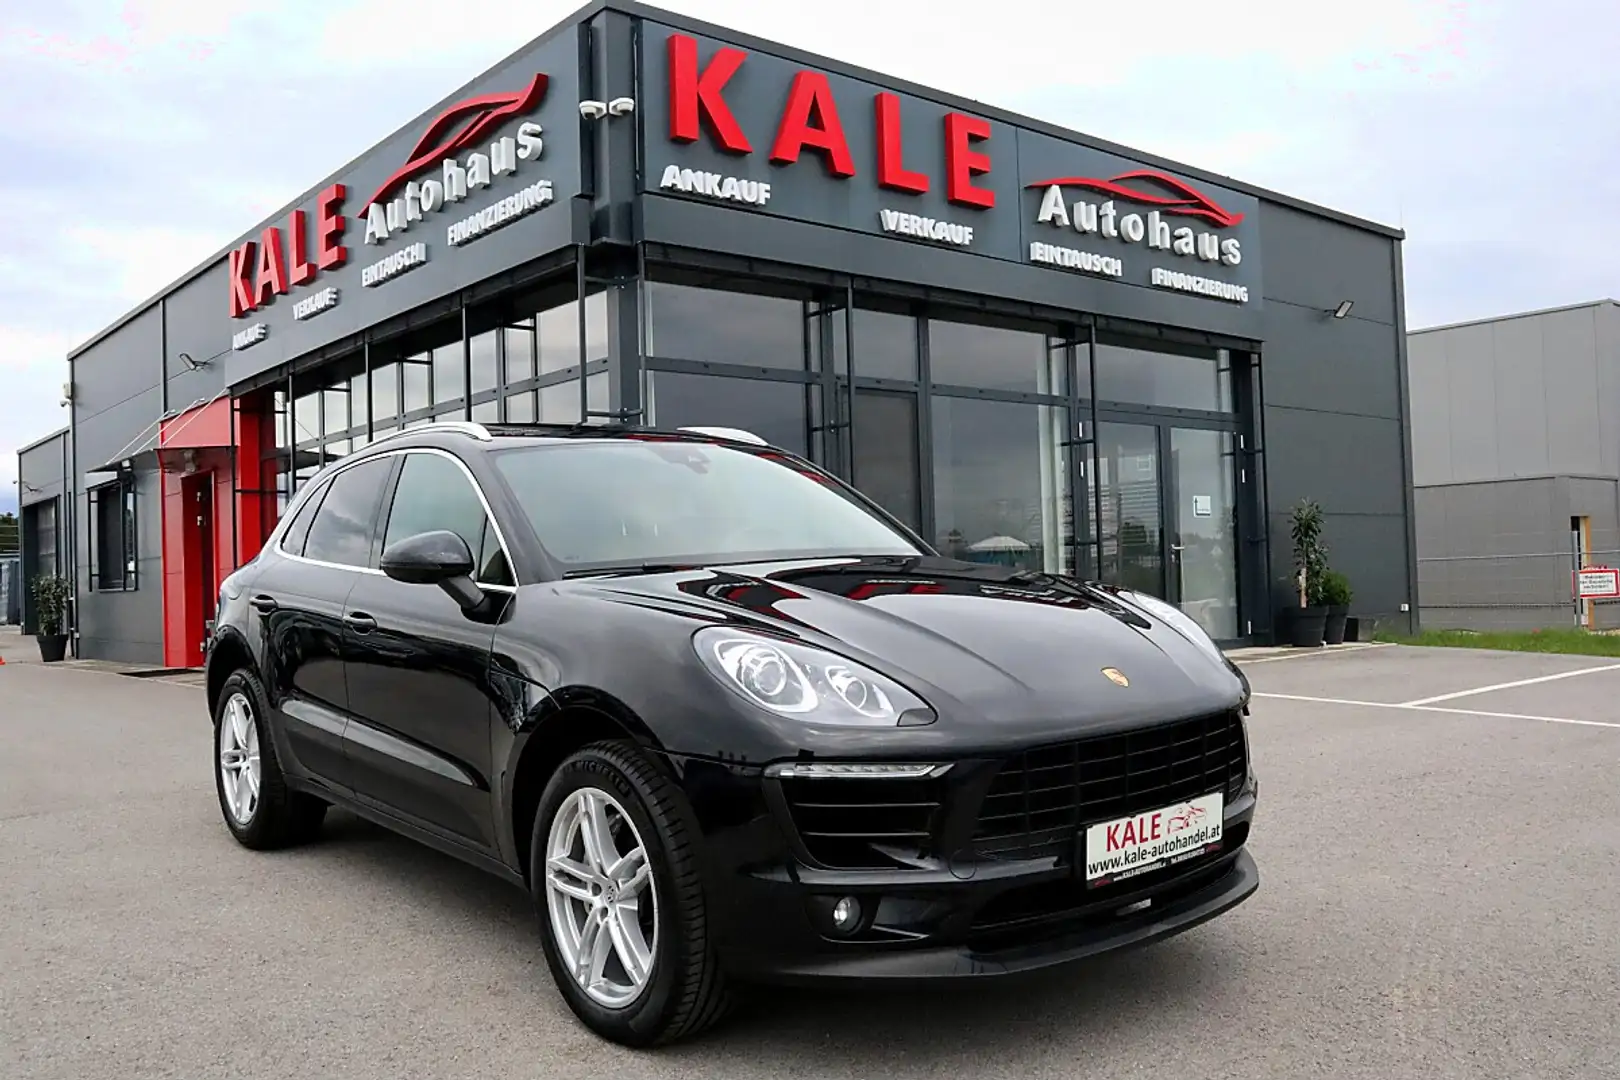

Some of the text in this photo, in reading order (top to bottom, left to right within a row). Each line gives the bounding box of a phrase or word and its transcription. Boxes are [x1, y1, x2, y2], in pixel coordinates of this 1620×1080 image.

[667, 33, 995, 210] KALE
[363, 121, 544, 244] Autohaus
[660, 164, 771, 206] ANKAUF
[447, 179, 554, 246] FINANZIERUNG
[879, 208, 974, 246] VERKAUF
[1037, 184, 1243, 266] Autohaus
[228, 183, 347, 318] KALE
[361, 242, 427, 288] EINTAUSCH
[1029, 241, 1123, 277] EINTAUSCH
[1151, 267, 1249, 303] FINANZIERUNG
[1088, 823, 1221, 875] www.kale-autohandel.at
[1106, 812, 1163, 853] KALE
